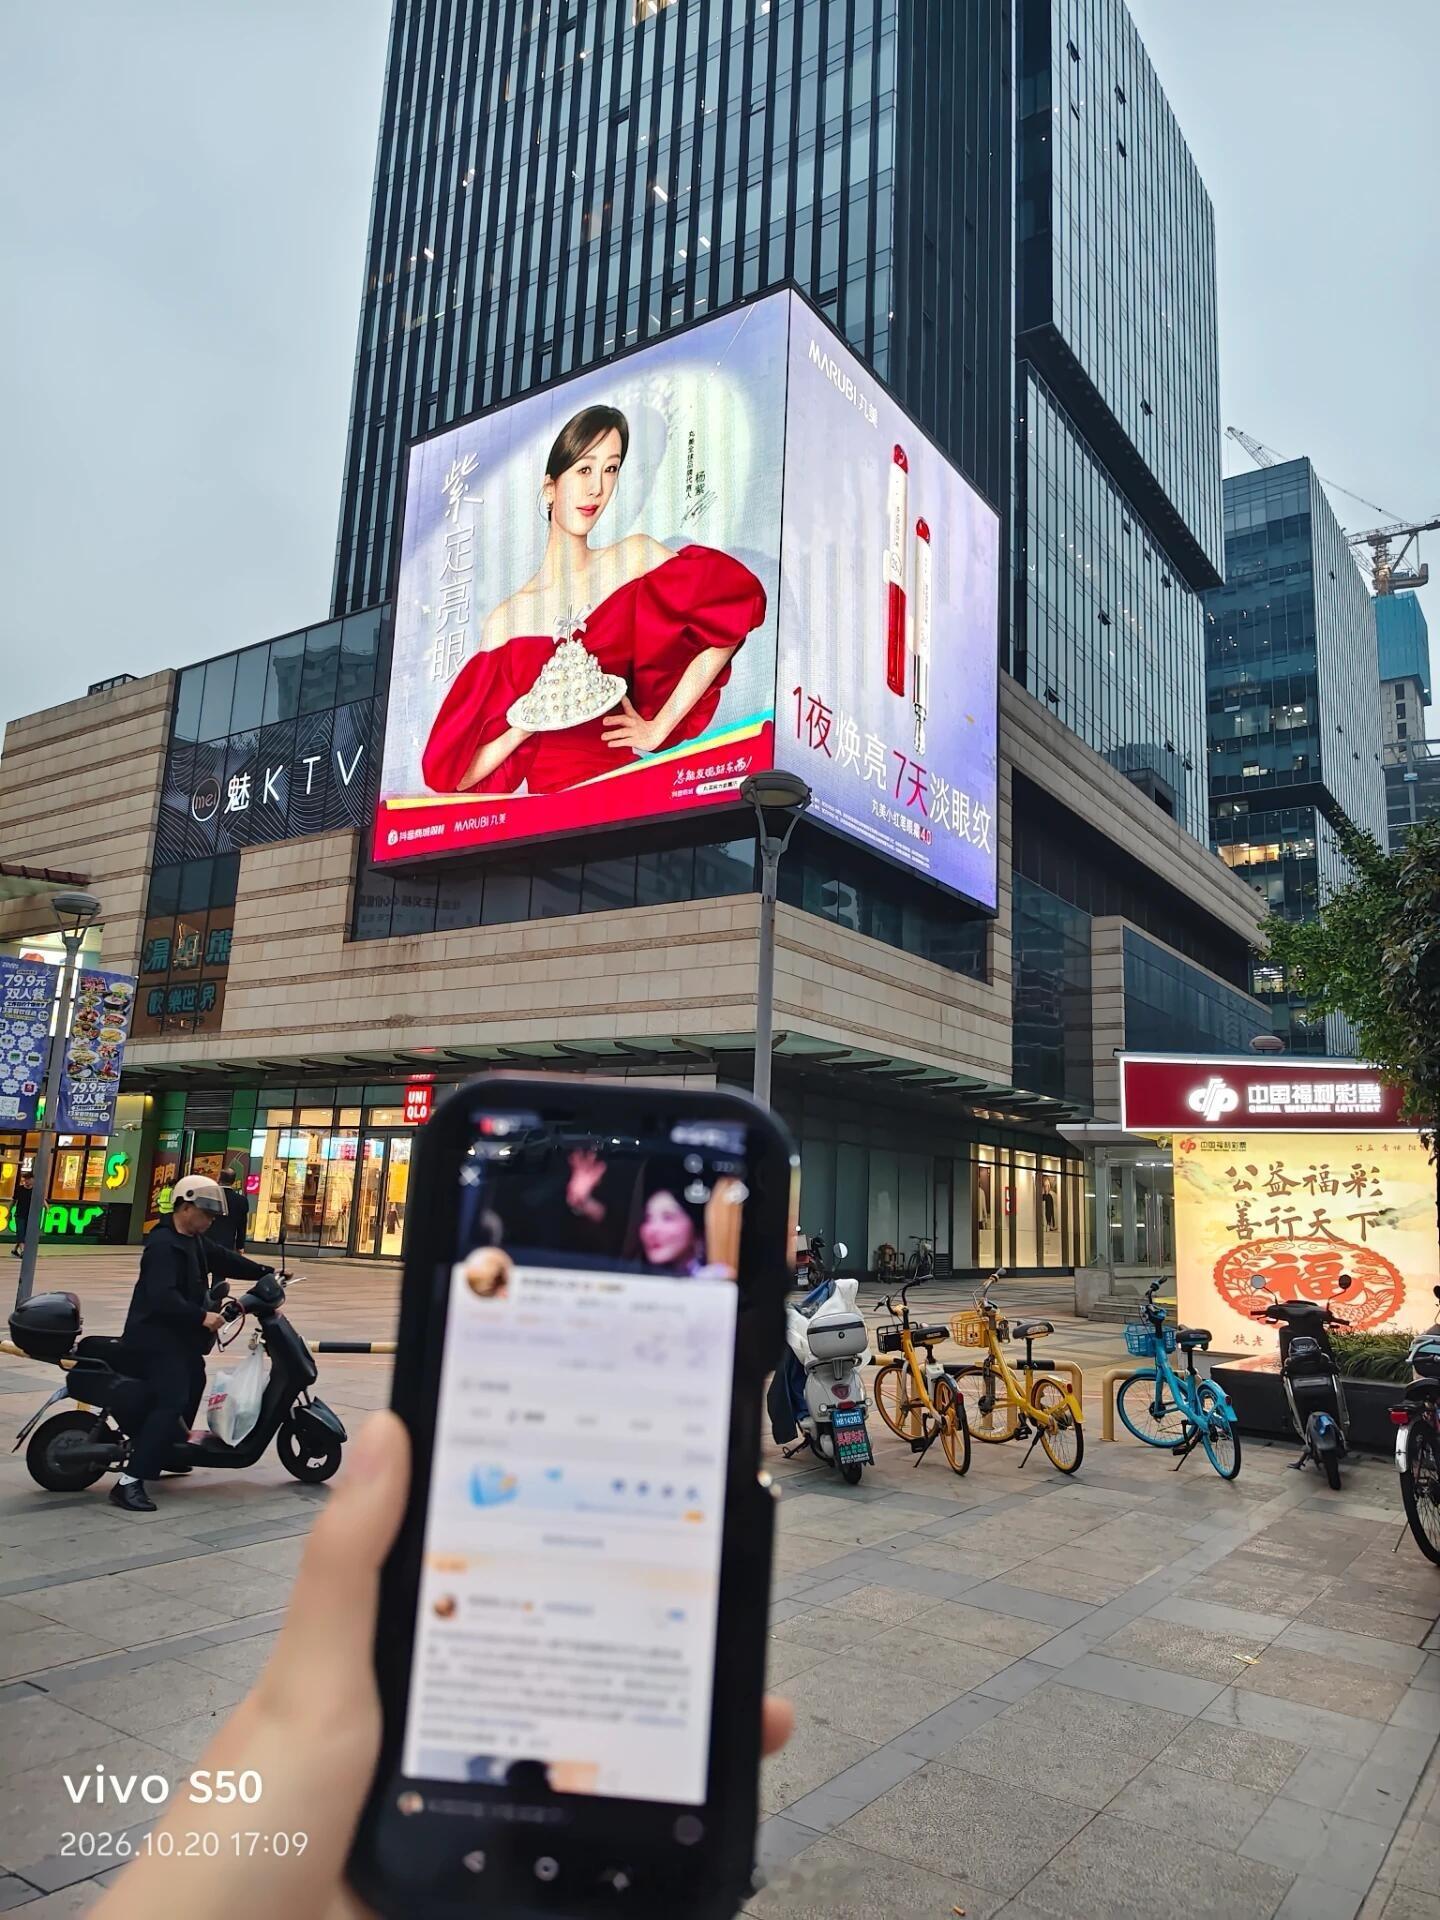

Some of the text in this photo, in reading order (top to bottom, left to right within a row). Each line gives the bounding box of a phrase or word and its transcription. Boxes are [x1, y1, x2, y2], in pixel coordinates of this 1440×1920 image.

[809, 339, 878, 428] MARUBI 丸美
[224, 772, 252, 814] 魅
[262, 745, 364, 804] KTV
[454, 813, 506, 832] MARUBI 丸美
[4, 974, 47, 988] 79.9元
[5, 987, 46, 1001] 双人餐
[71, 1082, 107, 1094] 79.9元
[408, 1090, 427, 1104] UNI
[1247, 1084, 1382, 1104] 中国福利彩票
[71, 1093, 106, 1105] 双人餐
[406, 1105, 427, 1119] QLO
[1225, 1160, 1383, 1198] 公益福彩
[1226, 1200, 1380, 1242] 善行天下
[1257, 1251, 1365, 1305] 福
